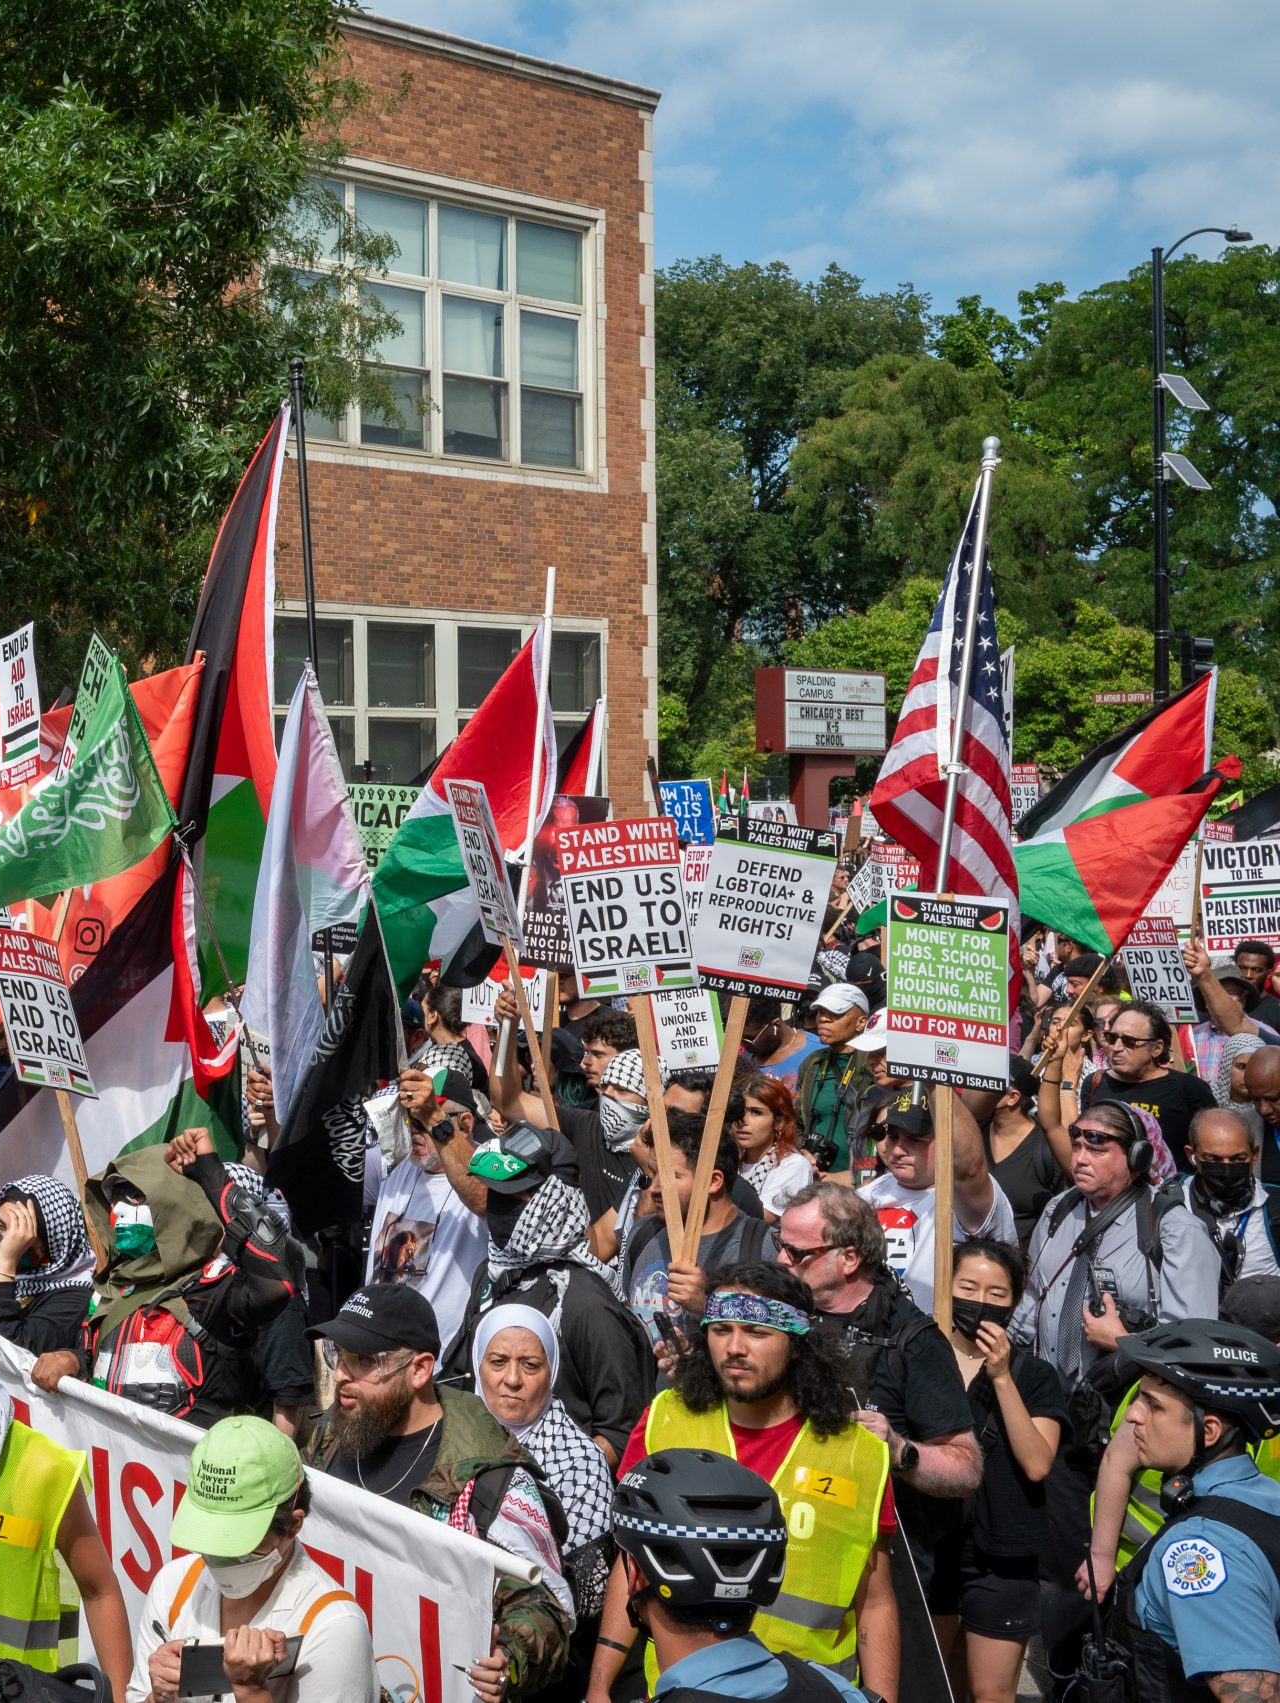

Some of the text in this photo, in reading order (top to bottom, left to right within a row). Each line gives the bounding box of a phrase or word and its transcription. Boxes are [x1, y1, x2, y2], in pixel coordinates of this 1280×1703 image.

[2, 630, 29, 662] END US
[90, 640, 110, 672] FROM
[11, 657, 25, 685] AID
[796, 675, 835, 687] SPALDING
[15, 683, 25, 703] TO
[799, 688, 833, 699] CAMPUS
[1104, 694, 1121, 703] ARTHUR
[1128, 693, 1145, 702] GRIFFIN
[7, 698, 35, 728] ISRAEL
[800, 707, 865, 720] CHICAGO'S BEST
[826, 721, 839, 733] K-5
[815, 734, 845, 746] SCHOOL
[1022, 766, 1036, 774] WITH
[1011, 786, 1036, 796] ND U.S
[559, 825, 621, 850] STAND
[625, 821, 673, 841] WITH
[747, 820, 814, 840] STAND WITH
[1216, 824, 1233, 834] WITH
[463, 829, 481, 850] END
[748, 832, 809, 851] PALESTINE!
[561, 842, 676, 871] PALESTINE!
[687, 850, 705, 862] STOP
[886, 847, 904, 855] WITH
[469, 853, 487, 877] AID
[737, 859, 803, 883] DEFEND
[871, 864, 883, 876] END
[898, 864, 920, 876] STAN
[871, 876, 883, 888] AID
[1230, 868, 1263, 881] TO THE
[570, 877, 624, 904] END
[634, 871, 676, 897] U.S
[715, 874, 814, 904] LGBTQIA+ &
[708, 893, 816, 922] REPRODUCTIVE
[920, 901, 978, 918] STAND WITH
[576, 900, 681, 934] AID TO
[923, 913, 975, 928] PALESTINE!
[1150, 919, 1173, 930] WITH
[527, 924, 557, 937] FUND
[718, 913, 793, 941] RIGHTS!
[905, 927, 991, 951] MONEY FOR
[1127, 931, 1177, 944] ALESTINE!
[32, 938, 59, 961] WITH
[579, 930, 687, 963] ISRAEL!
[1126, 950, 1179, 965] END U.S
[627, 979, 648, 987] 2024
[1132, 967, 1185, 983] AID TO
[0, 978, 69, 1011] END U.S
[655, 988, 704, 1003] THE RIGHT
[709, 977, 802, 1001] U.S AID TO ISRAEL!
[969, 985, 1000, 1003] AND
[1135, 985, 1190, 1001] ISRAEL!
[674, 1001, 688, 1013] TO
[892, 992, 1001, 1021] ENVIRONMENT!
[9, 1003, 76, 1039] AID TO
[661, 1011, 707, 1027] UNIONIZE
[675, 1025, 696, 1037] AND
[891, 1013, 1002, 1043] NOT FOR WAR!
[12, 1030, 84, 1066] ISRAEL!
[671, 1036, 709, 1050] STRIKE!
[936, 1055, 956, 1064] 2024
[890, 1064, 1003, 1091] END U.S AID TO ISRAEL!
[349, 1292, 370, 1305] Free
[1213, 1347, 1259, 1364] POLICE
[200, 1459, 236, 1476] National
[197, 1468, 236, 1485] Lawyers
[193, 1485, 205, 1497] Legal
[200, 1481, 227, 1495] Guild
[812, 1475, 837, 1496] 1
[1167, 1543, 1216, 1568] CHICAGO
[1173, 1570, 1217, 1591] POLICE
[724, 1587, 740, 1597] K5
